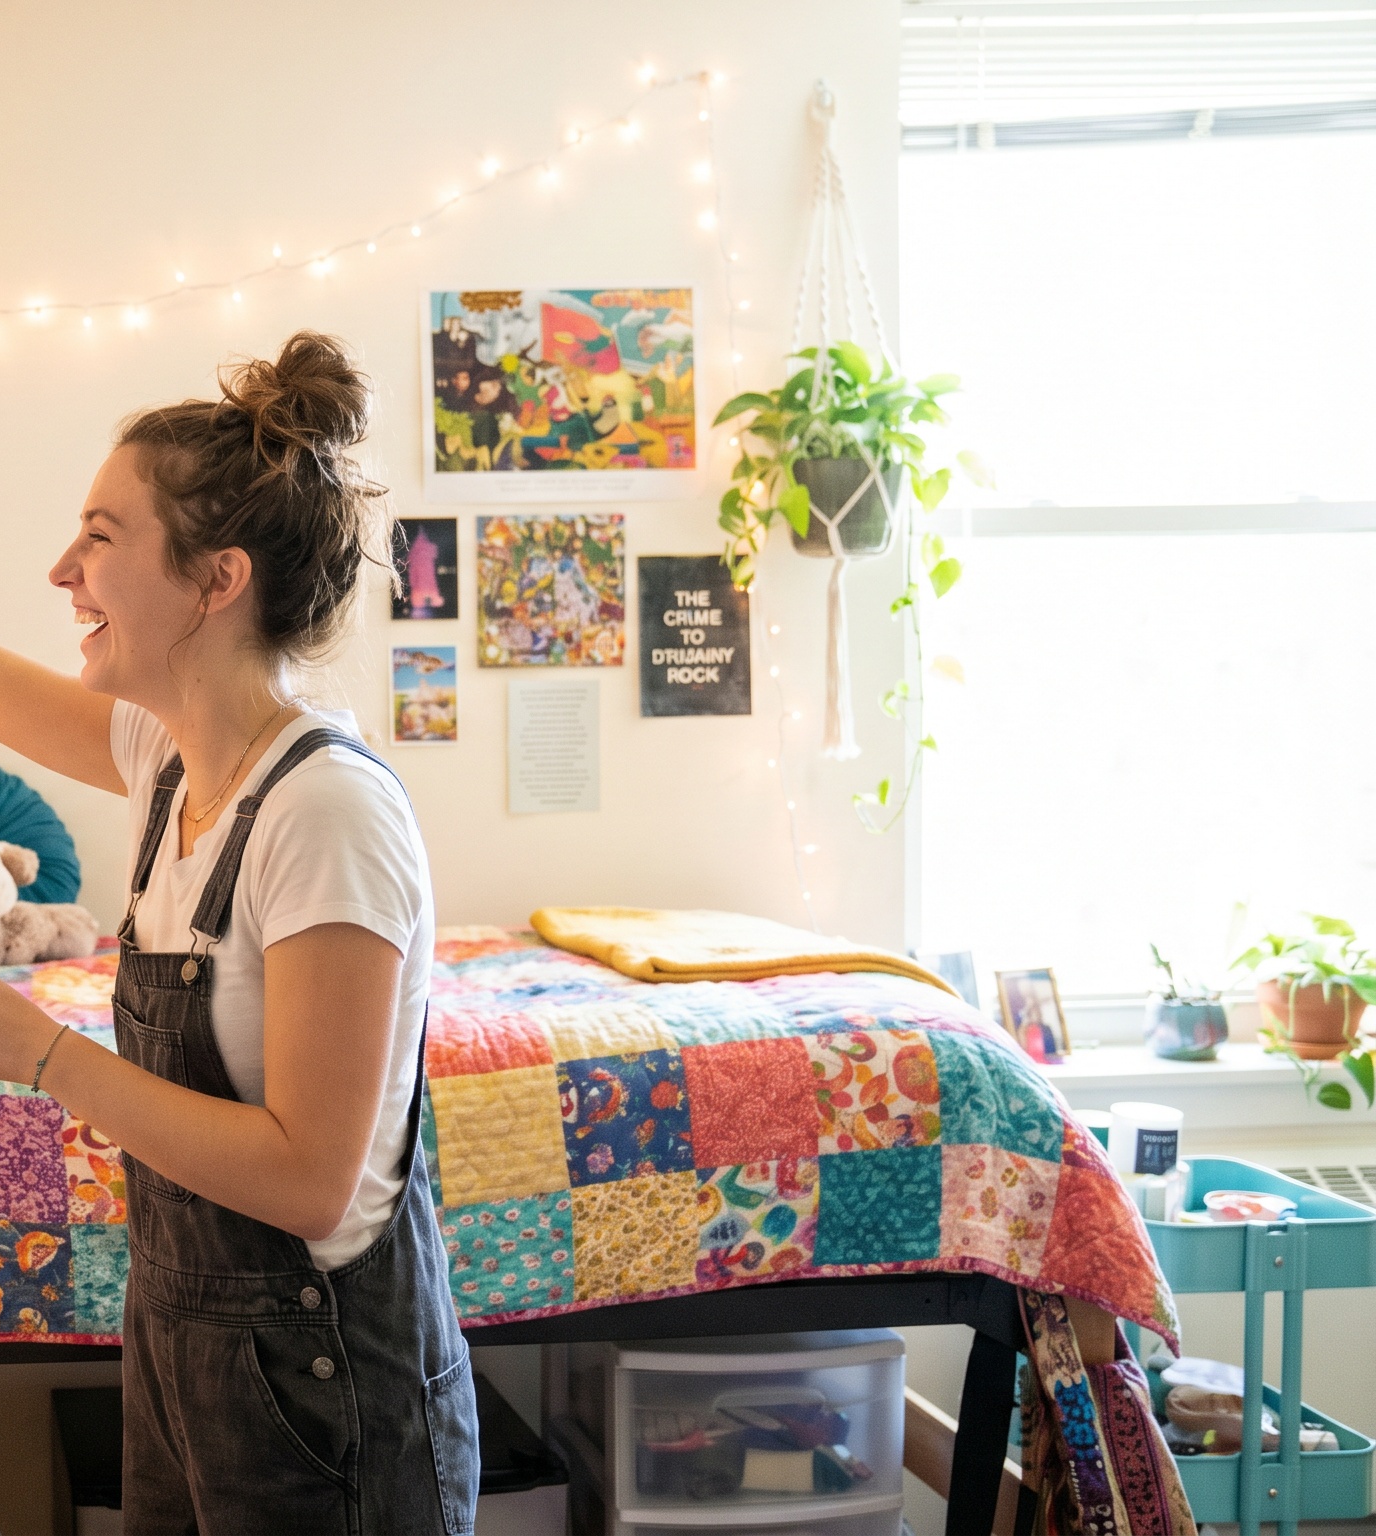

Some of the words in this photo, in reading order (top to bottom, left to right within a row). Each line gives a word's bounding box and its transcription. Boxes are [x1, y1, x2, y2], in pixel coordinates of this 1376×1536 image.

[674, 590, 711, 607] THE
[680, 628, 706, 645] TO
[667, 667, 720, 684] ROCK
